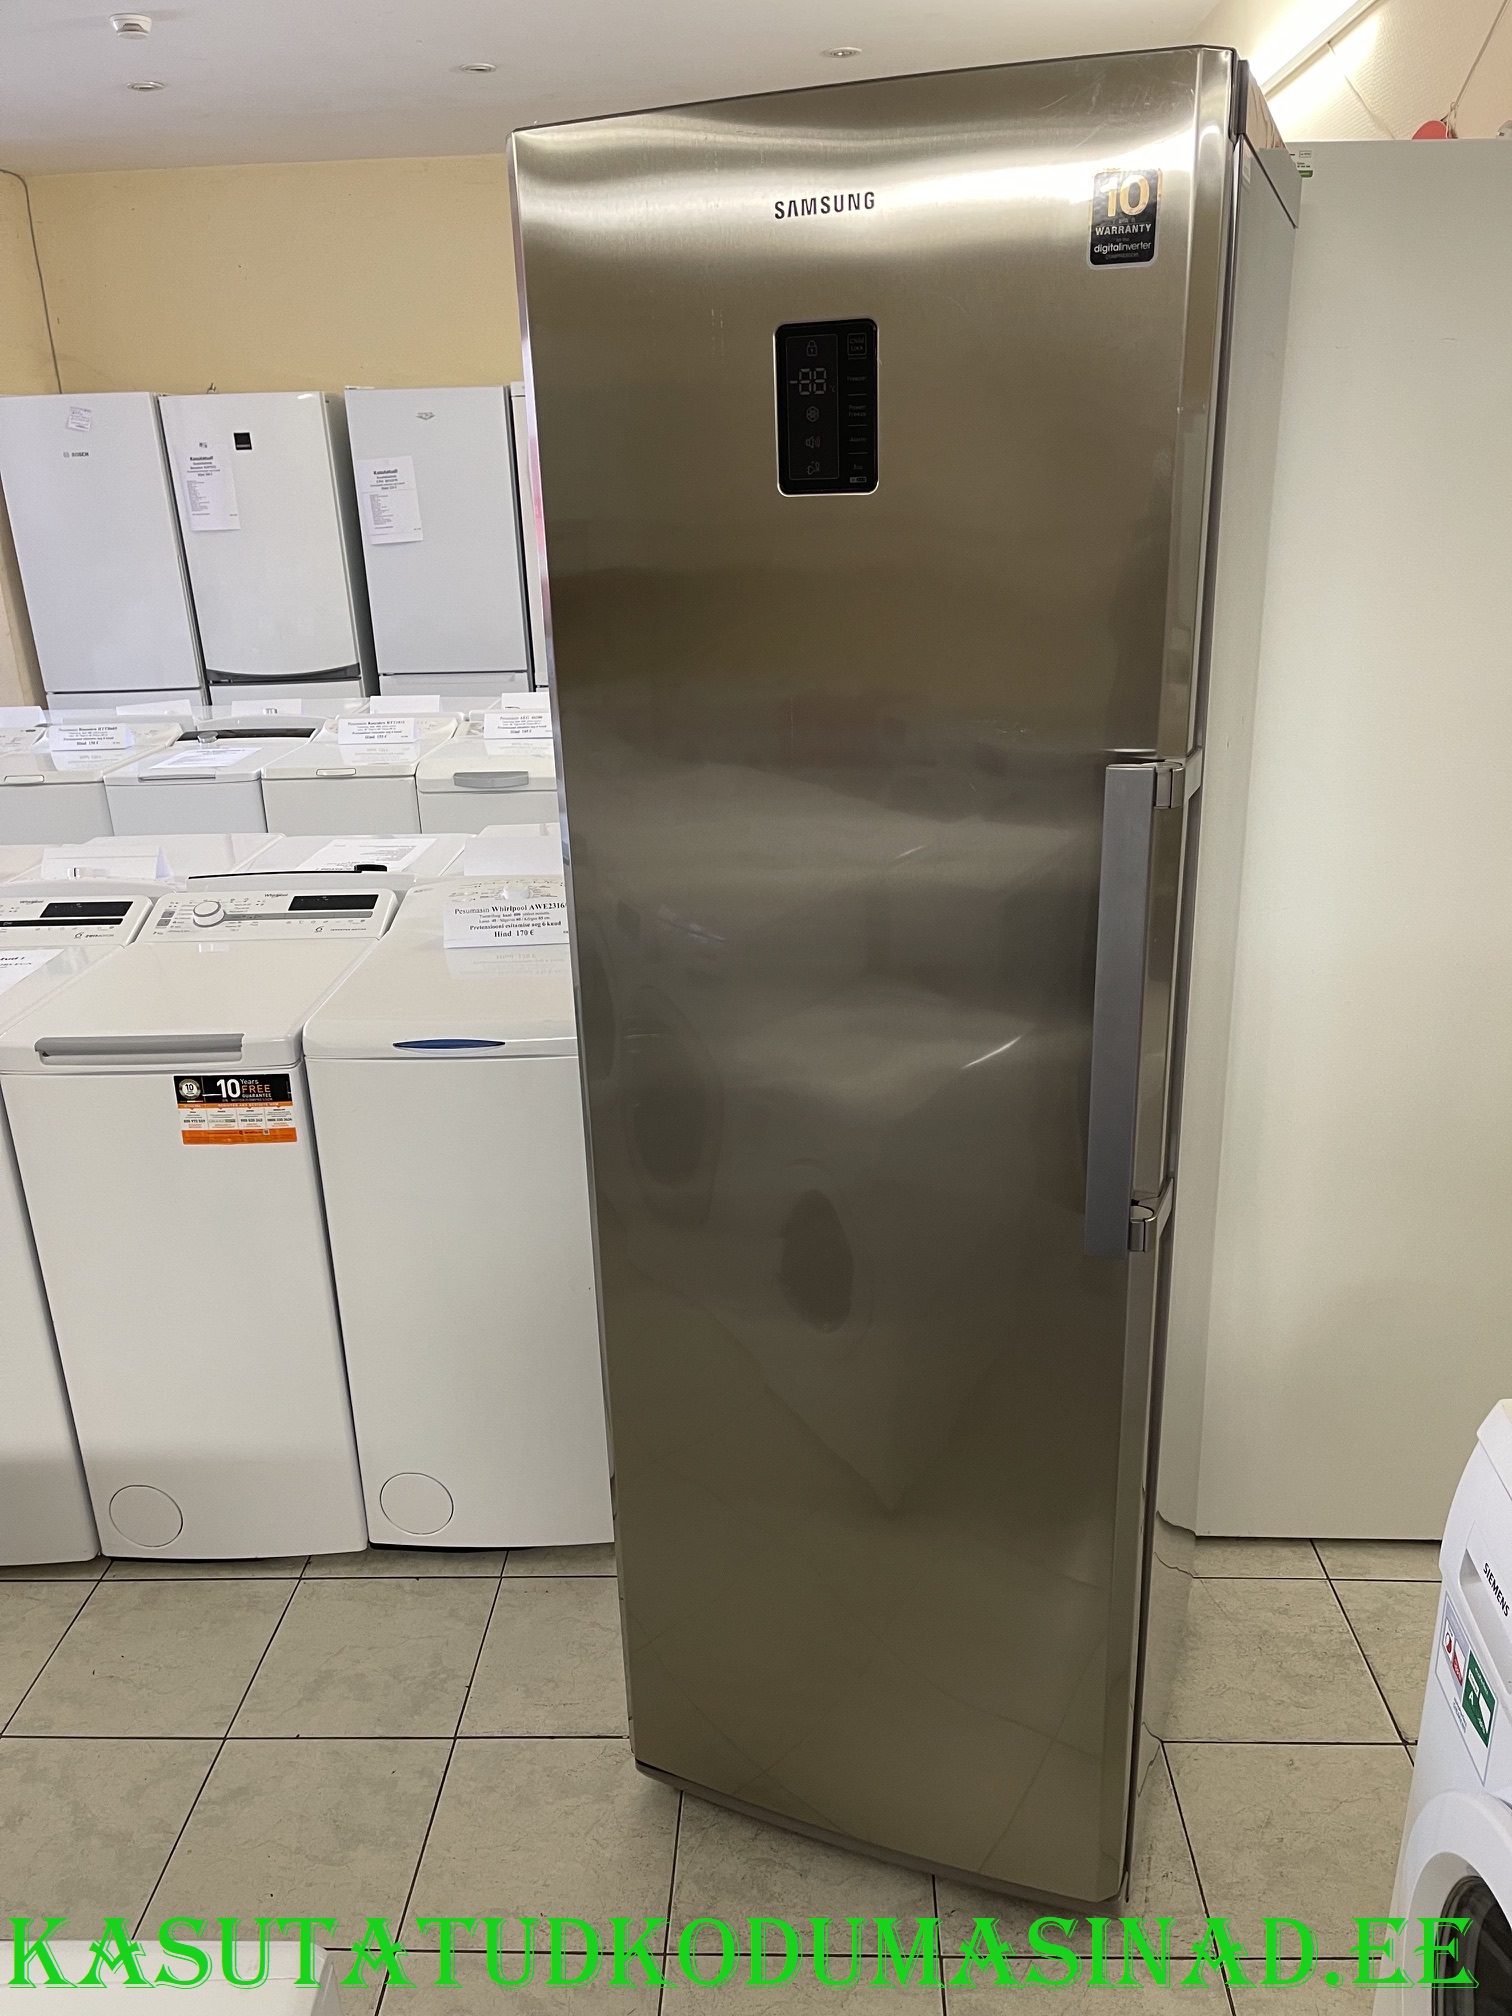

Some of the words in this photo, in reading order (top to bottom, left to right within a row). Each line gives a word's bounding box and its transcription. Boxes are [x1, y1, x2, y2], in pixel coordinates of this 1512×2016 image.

[1100, 174, 1150, 217] 10
[774, 191, 875, 220] SAMSUNG
[1095, 223, 1152, 236] WARRANTY
[454, 907, 490, 915] Pesumasin
[491, 904, 528, 913] Whirlpool
[528, 902, 568, 911] AWE2316
[494, 930, 512, 938] Hind
[184, 1083, 195, 1091] 10
[216, 1078, 241, 1099] 10
[241, 1084, 271, 1094] FREE
[1482, 1562, 1511, 1618] SIEMENS
